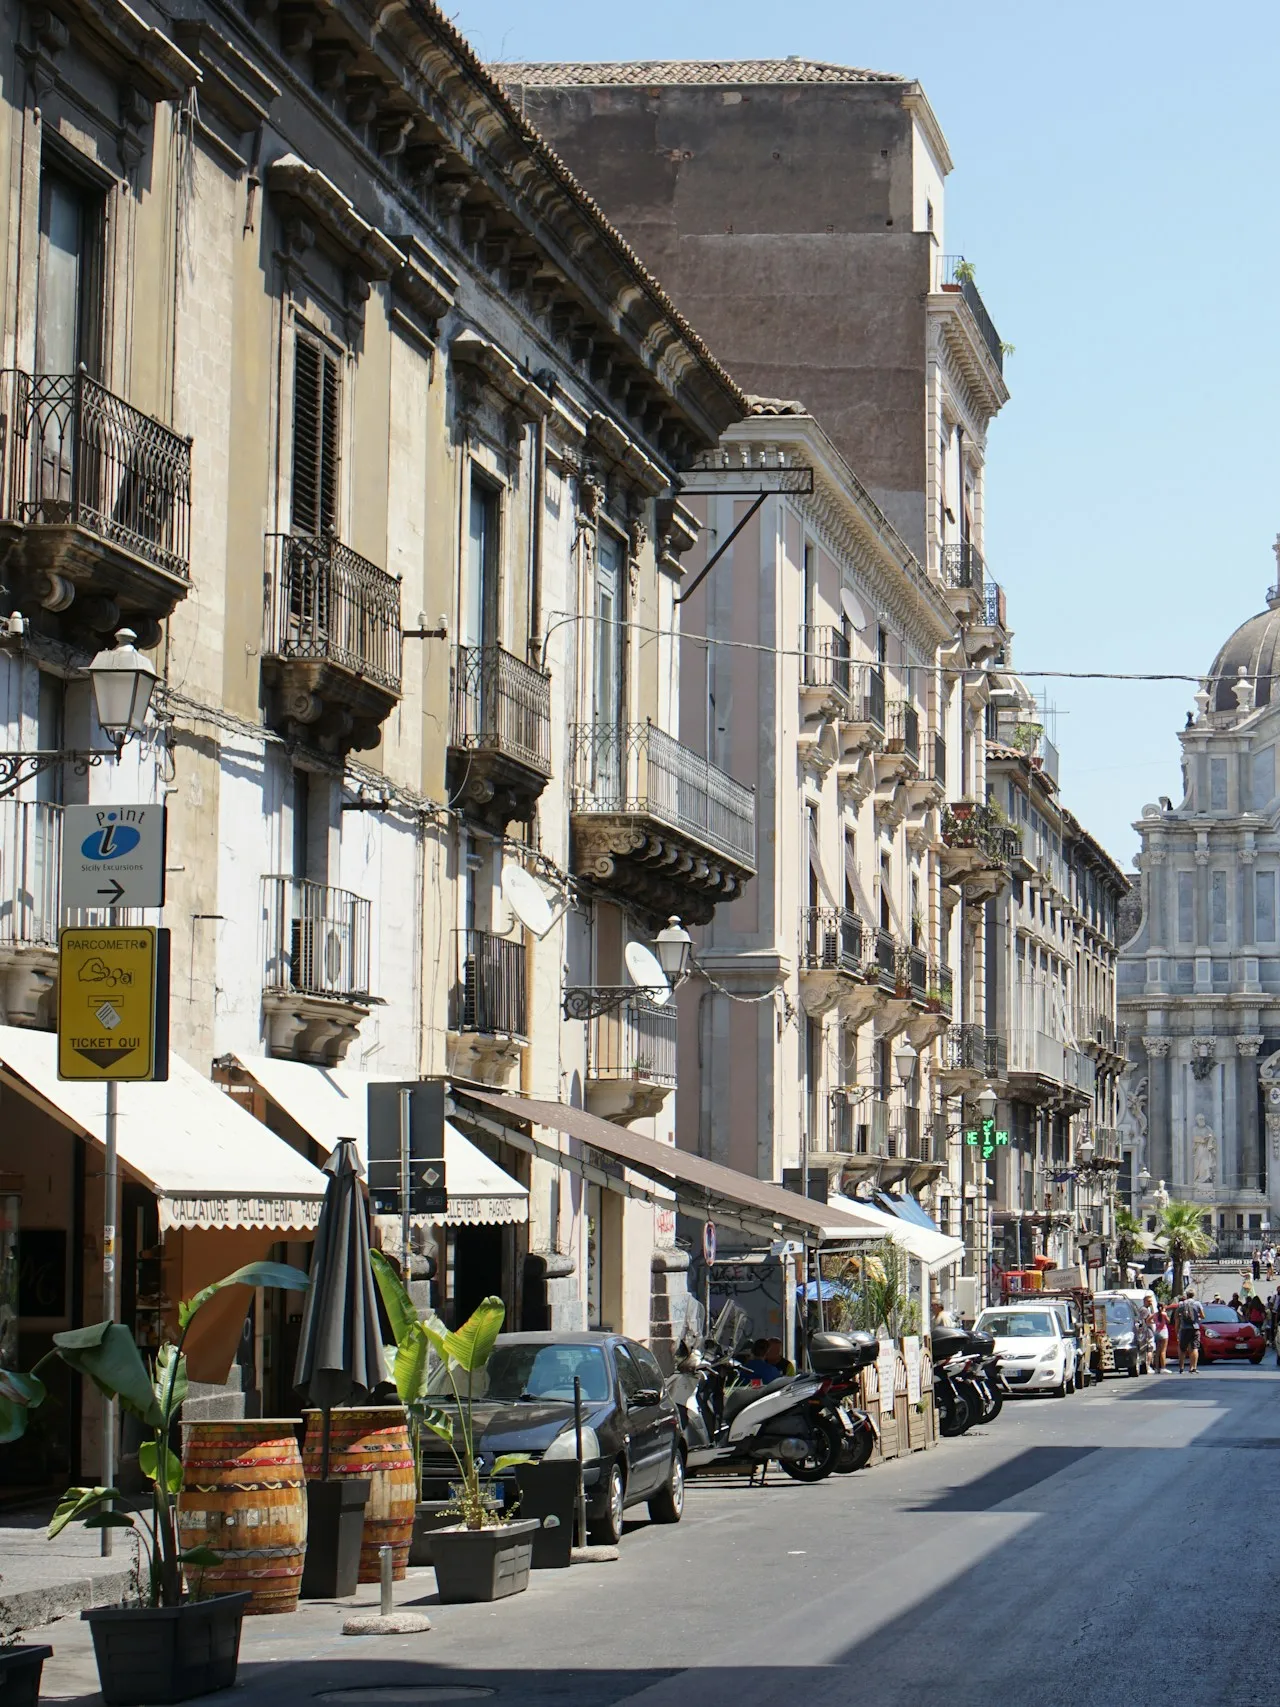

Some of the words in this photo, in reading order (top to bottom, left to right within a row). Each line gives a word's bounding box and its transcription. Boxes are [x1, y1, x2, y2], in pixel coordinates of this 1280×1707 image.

[81, 864, 101, 872] Sicily
[103, 863, 143, 871] Excursions
[70, 1037, 112, 1049] TICKET
[118, 1037, 140, 1048] QUI
[172, 1200, 229, 1221] CALZATURE
[236, 1200, 294, 1222] PELLETTERIA
[488, 1200, 512, 1218] FAGONE
